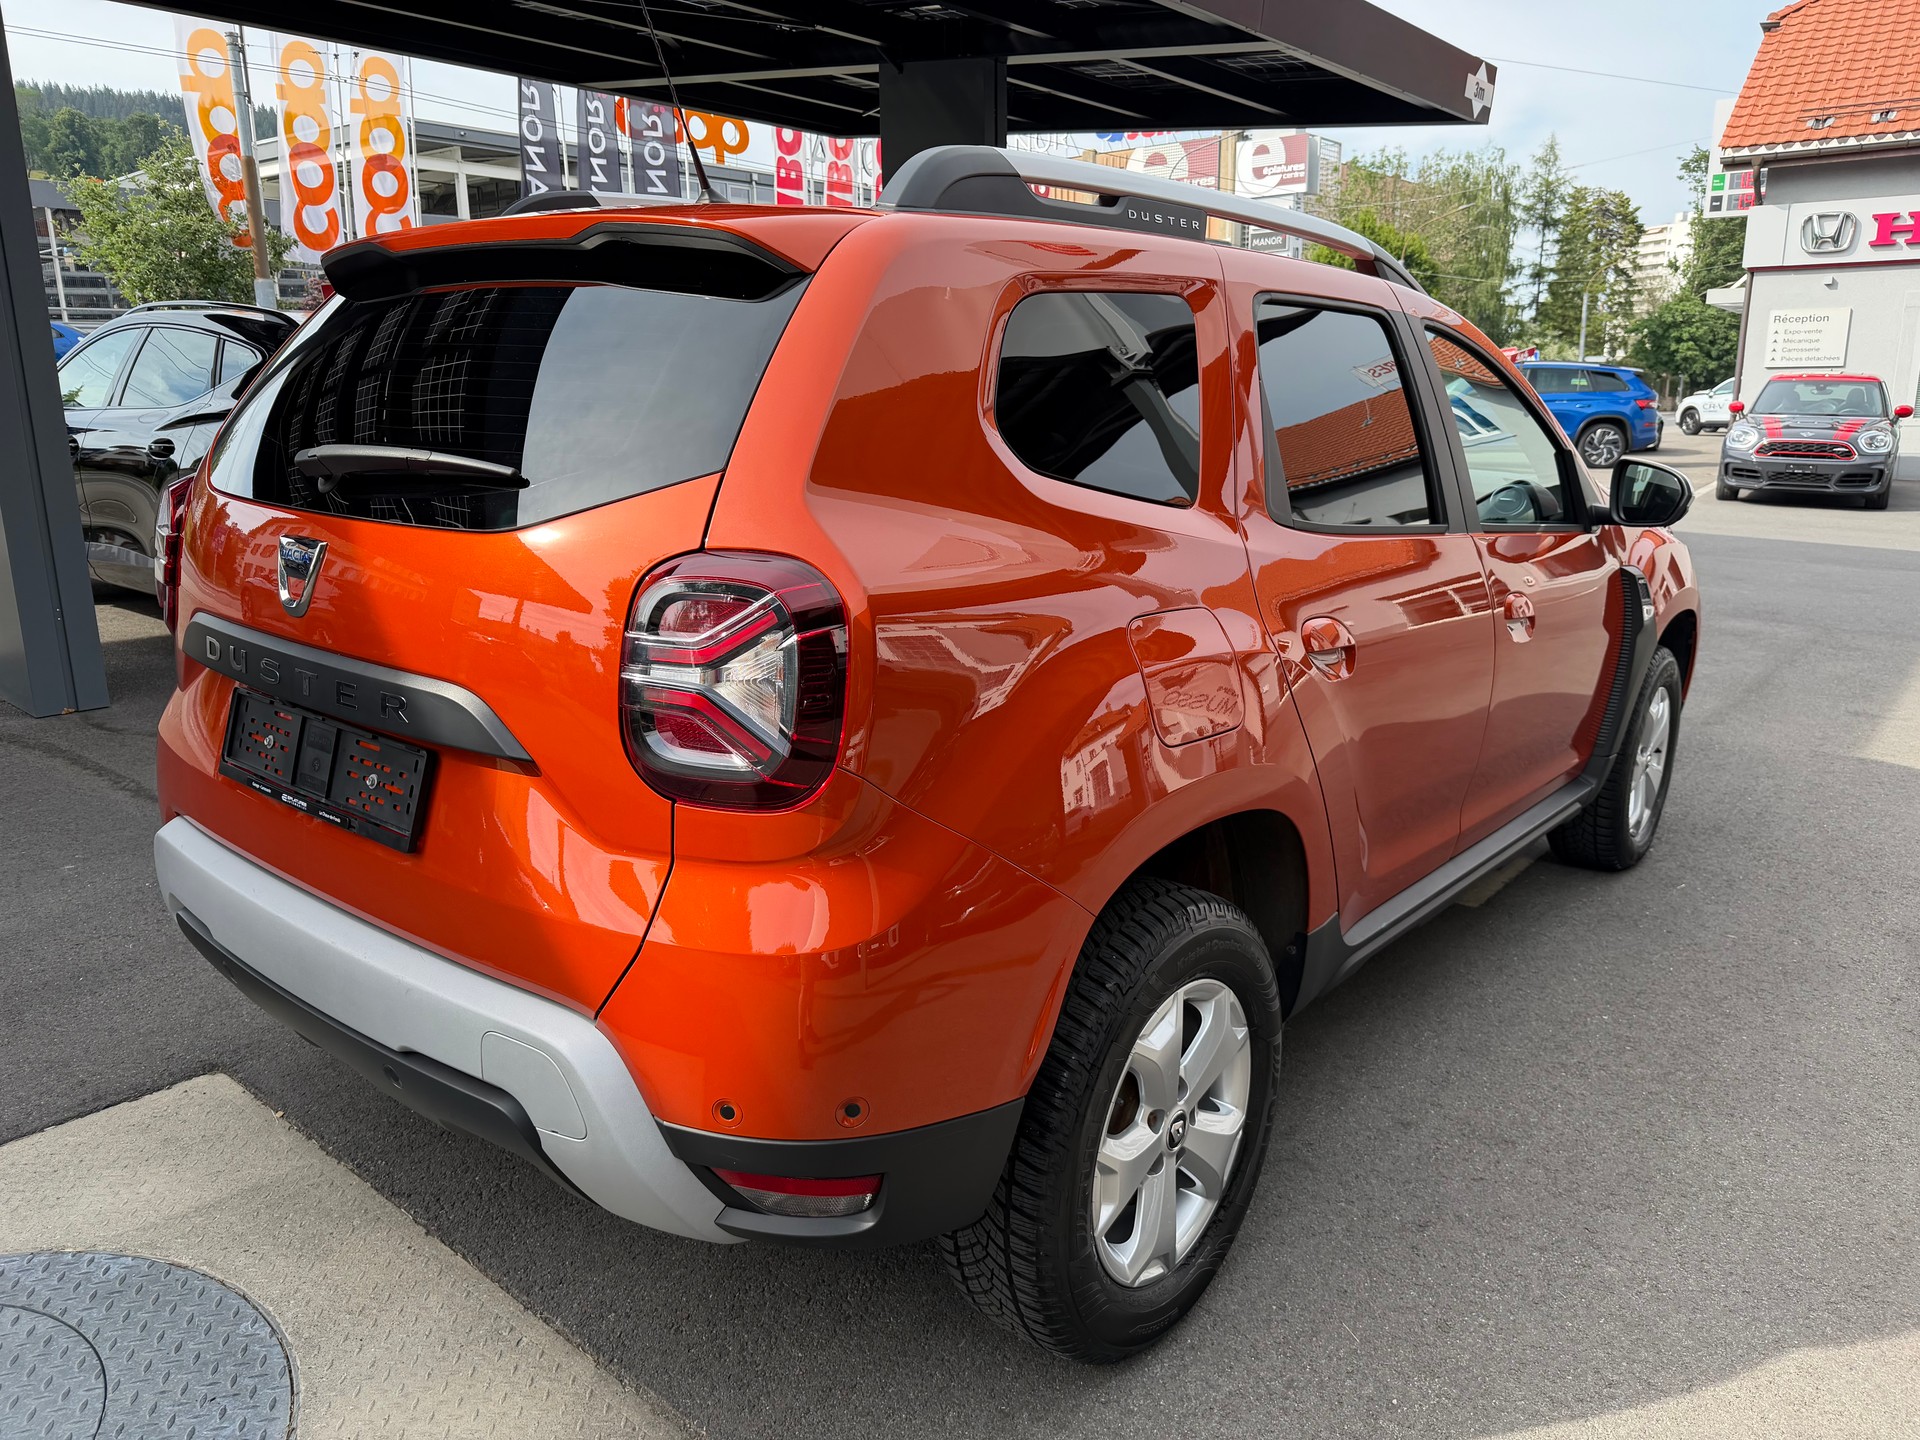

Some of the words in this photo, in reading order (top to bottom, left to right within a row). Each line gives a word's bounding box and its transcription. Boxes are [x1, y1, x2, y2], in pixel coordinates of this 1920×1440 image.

[1474, 81, 1485, 101] 3m
[1127, 209, 1200, 230] DUSTER
[1252, 236, 1283, 247] MANOR
[1773, 314, 1830, 324] Réception
[1784, 328, 1823, 336] Expo-vente
[1783, 337, 1821, 345] Mécanique
[1702, 402, 1725, 410] CR-V
[205, 635, 409, 723] DUSTER
